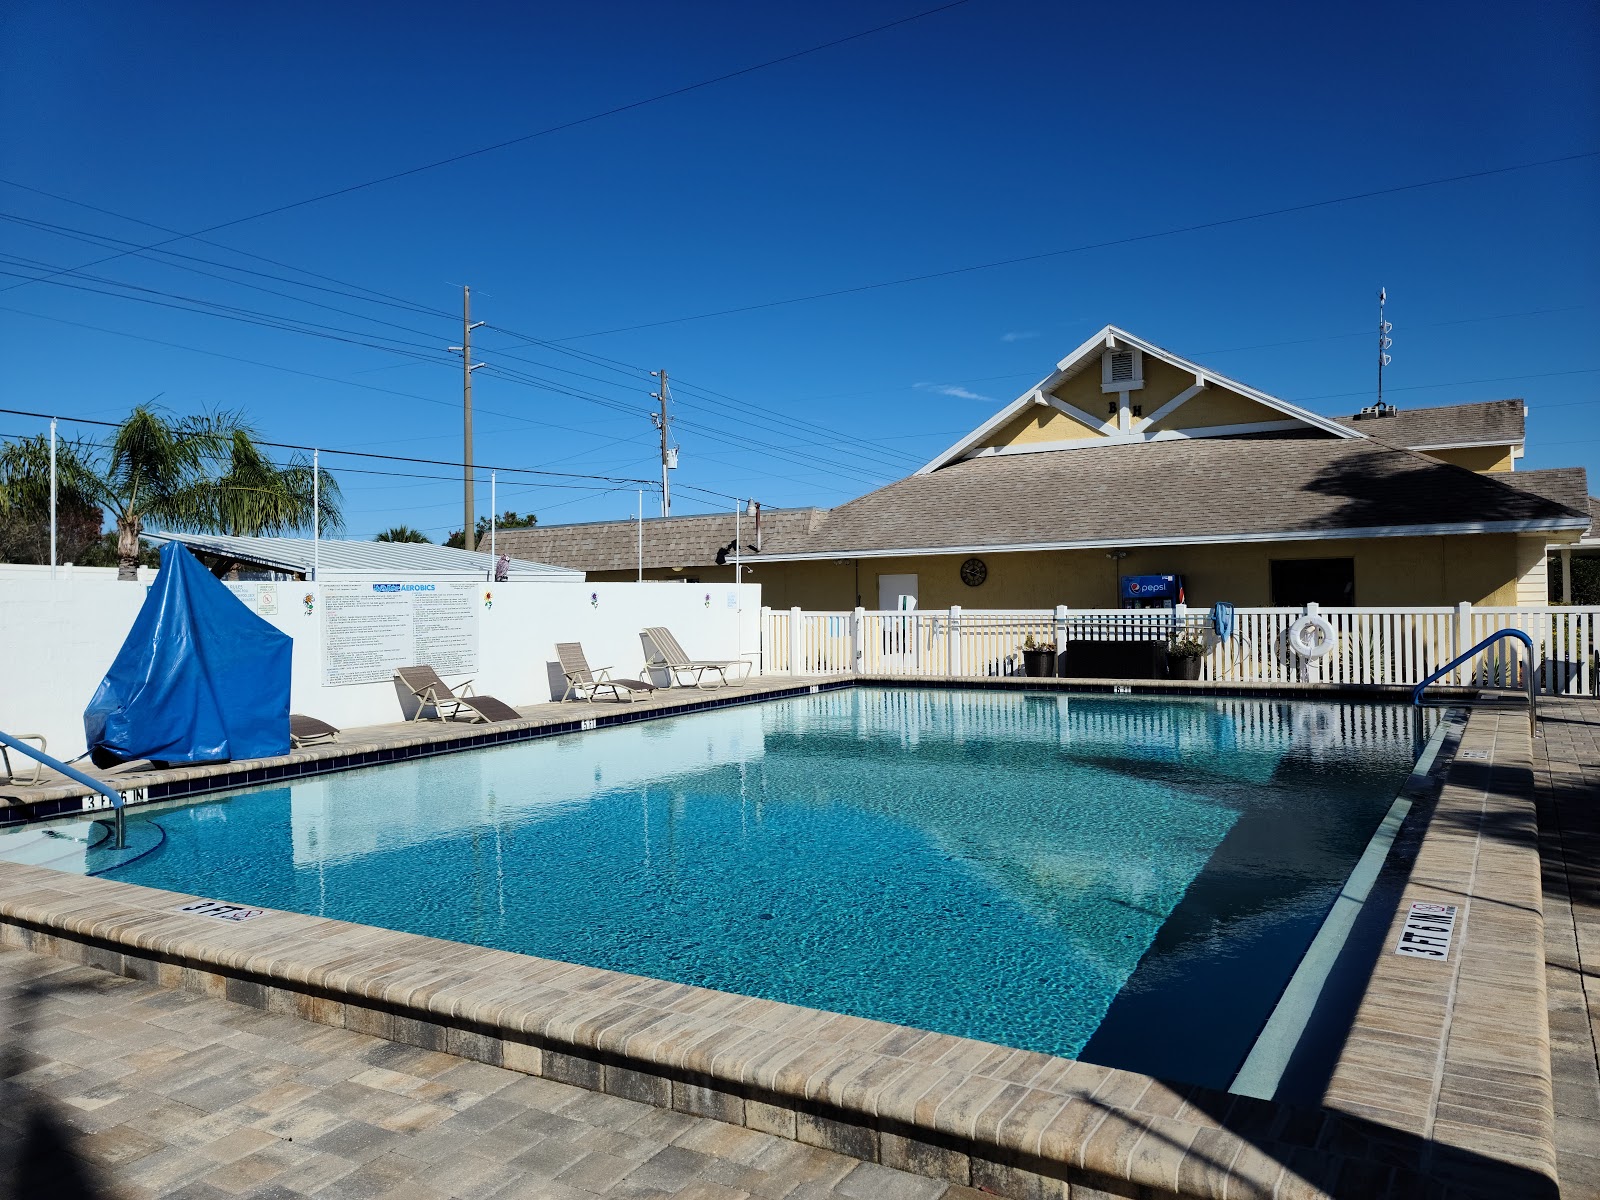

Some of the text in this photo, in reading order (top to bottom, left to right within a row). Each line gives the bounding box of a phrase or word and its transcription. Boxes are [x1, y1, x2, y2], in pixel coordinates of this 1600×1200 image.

[1108, 401, 1142, 417] B H
[401, 584, 436, 592] AEROBICS
[1141, 583, 1166, 593] pepsi
[88, 795, 95, 809] 3
[133, 788, 144, 802] IN
[182, 902, 246, 917] 3 FT
[1399, 911, 1453, 956] 3 FT 6 IN
